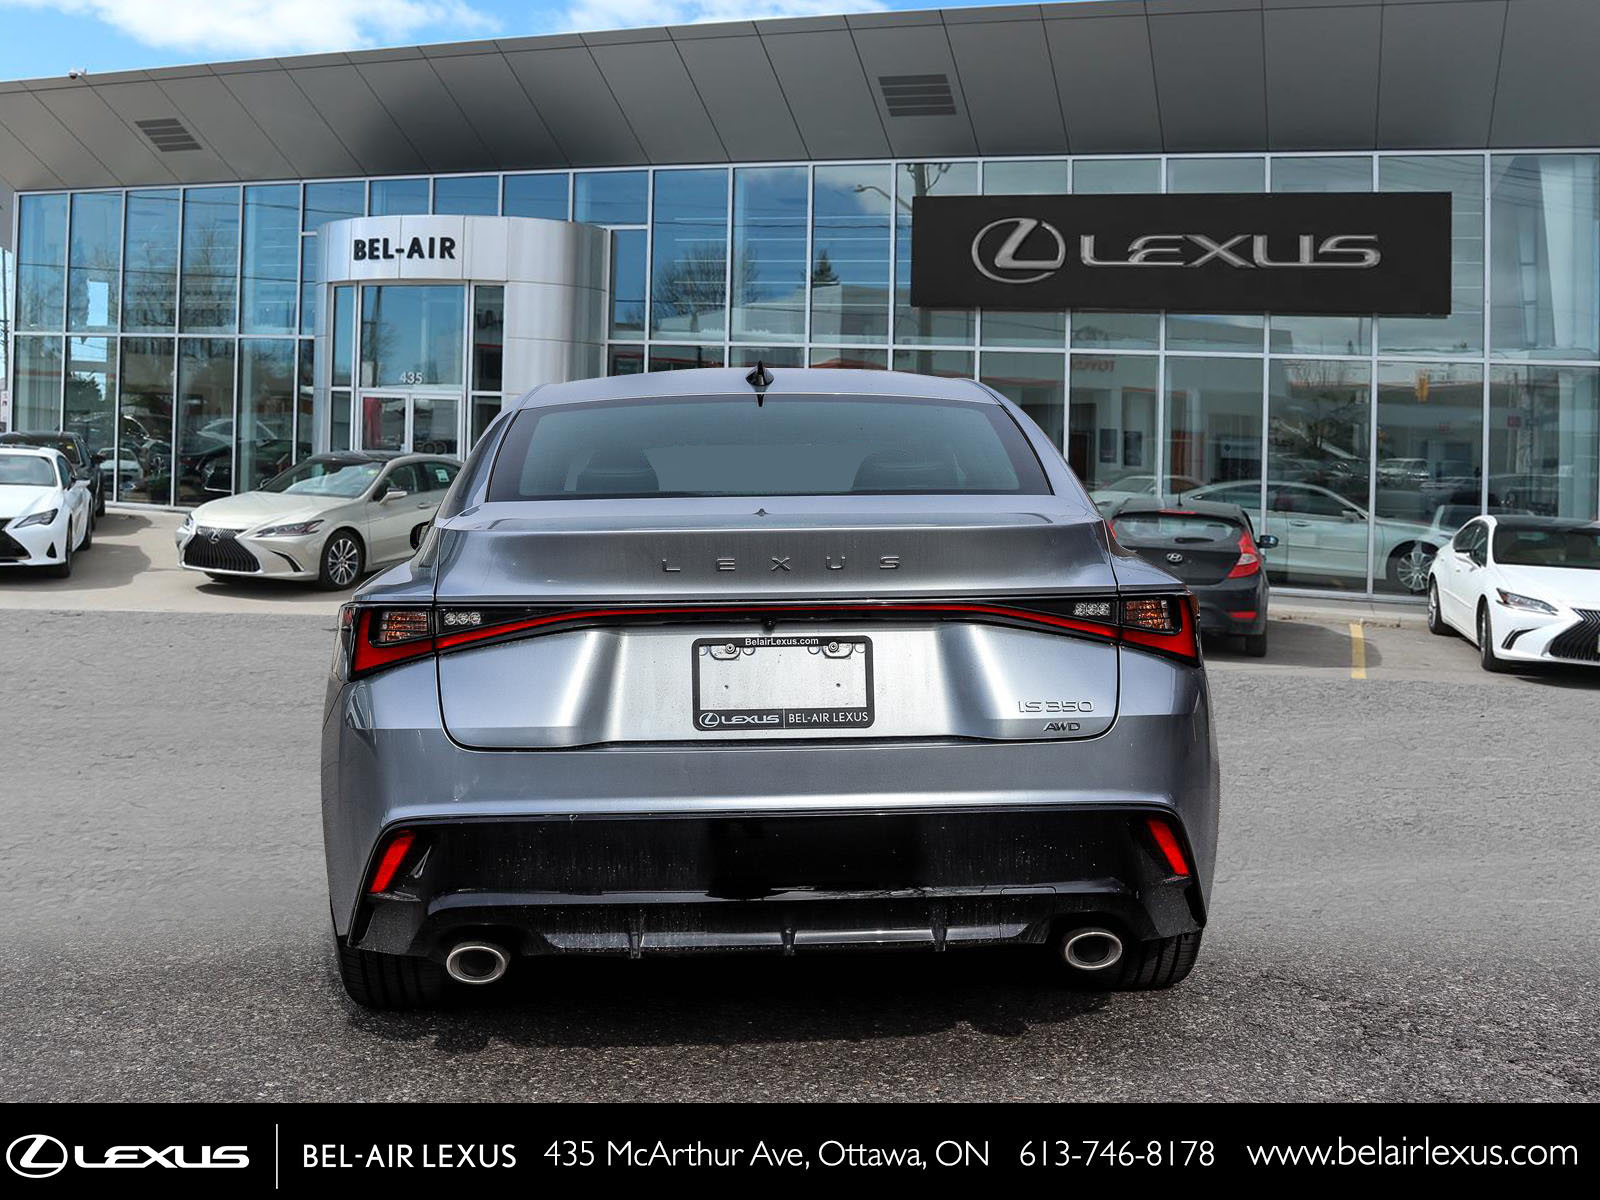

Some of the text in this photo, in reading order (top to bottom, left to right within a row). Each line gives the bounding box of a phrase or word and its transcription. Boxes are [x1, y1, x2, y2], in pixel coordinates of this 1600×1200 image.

[353, 237, 456, 260] BEL-AIR
[1080, 233, 1382, 268] LEXUS
[400, 371, 423, 384] 435
[662, 555, 901, 573] LEXUS
[744, 637, 819, 647] BelairLexus.com
[1018, 701, 1094, 713] IS 350
[721, 714, 780, 725] LEXUS
[788, 711, 869, 724] BEL-AIR LEXUS
[1043, 721, 1081, 732] AWD
